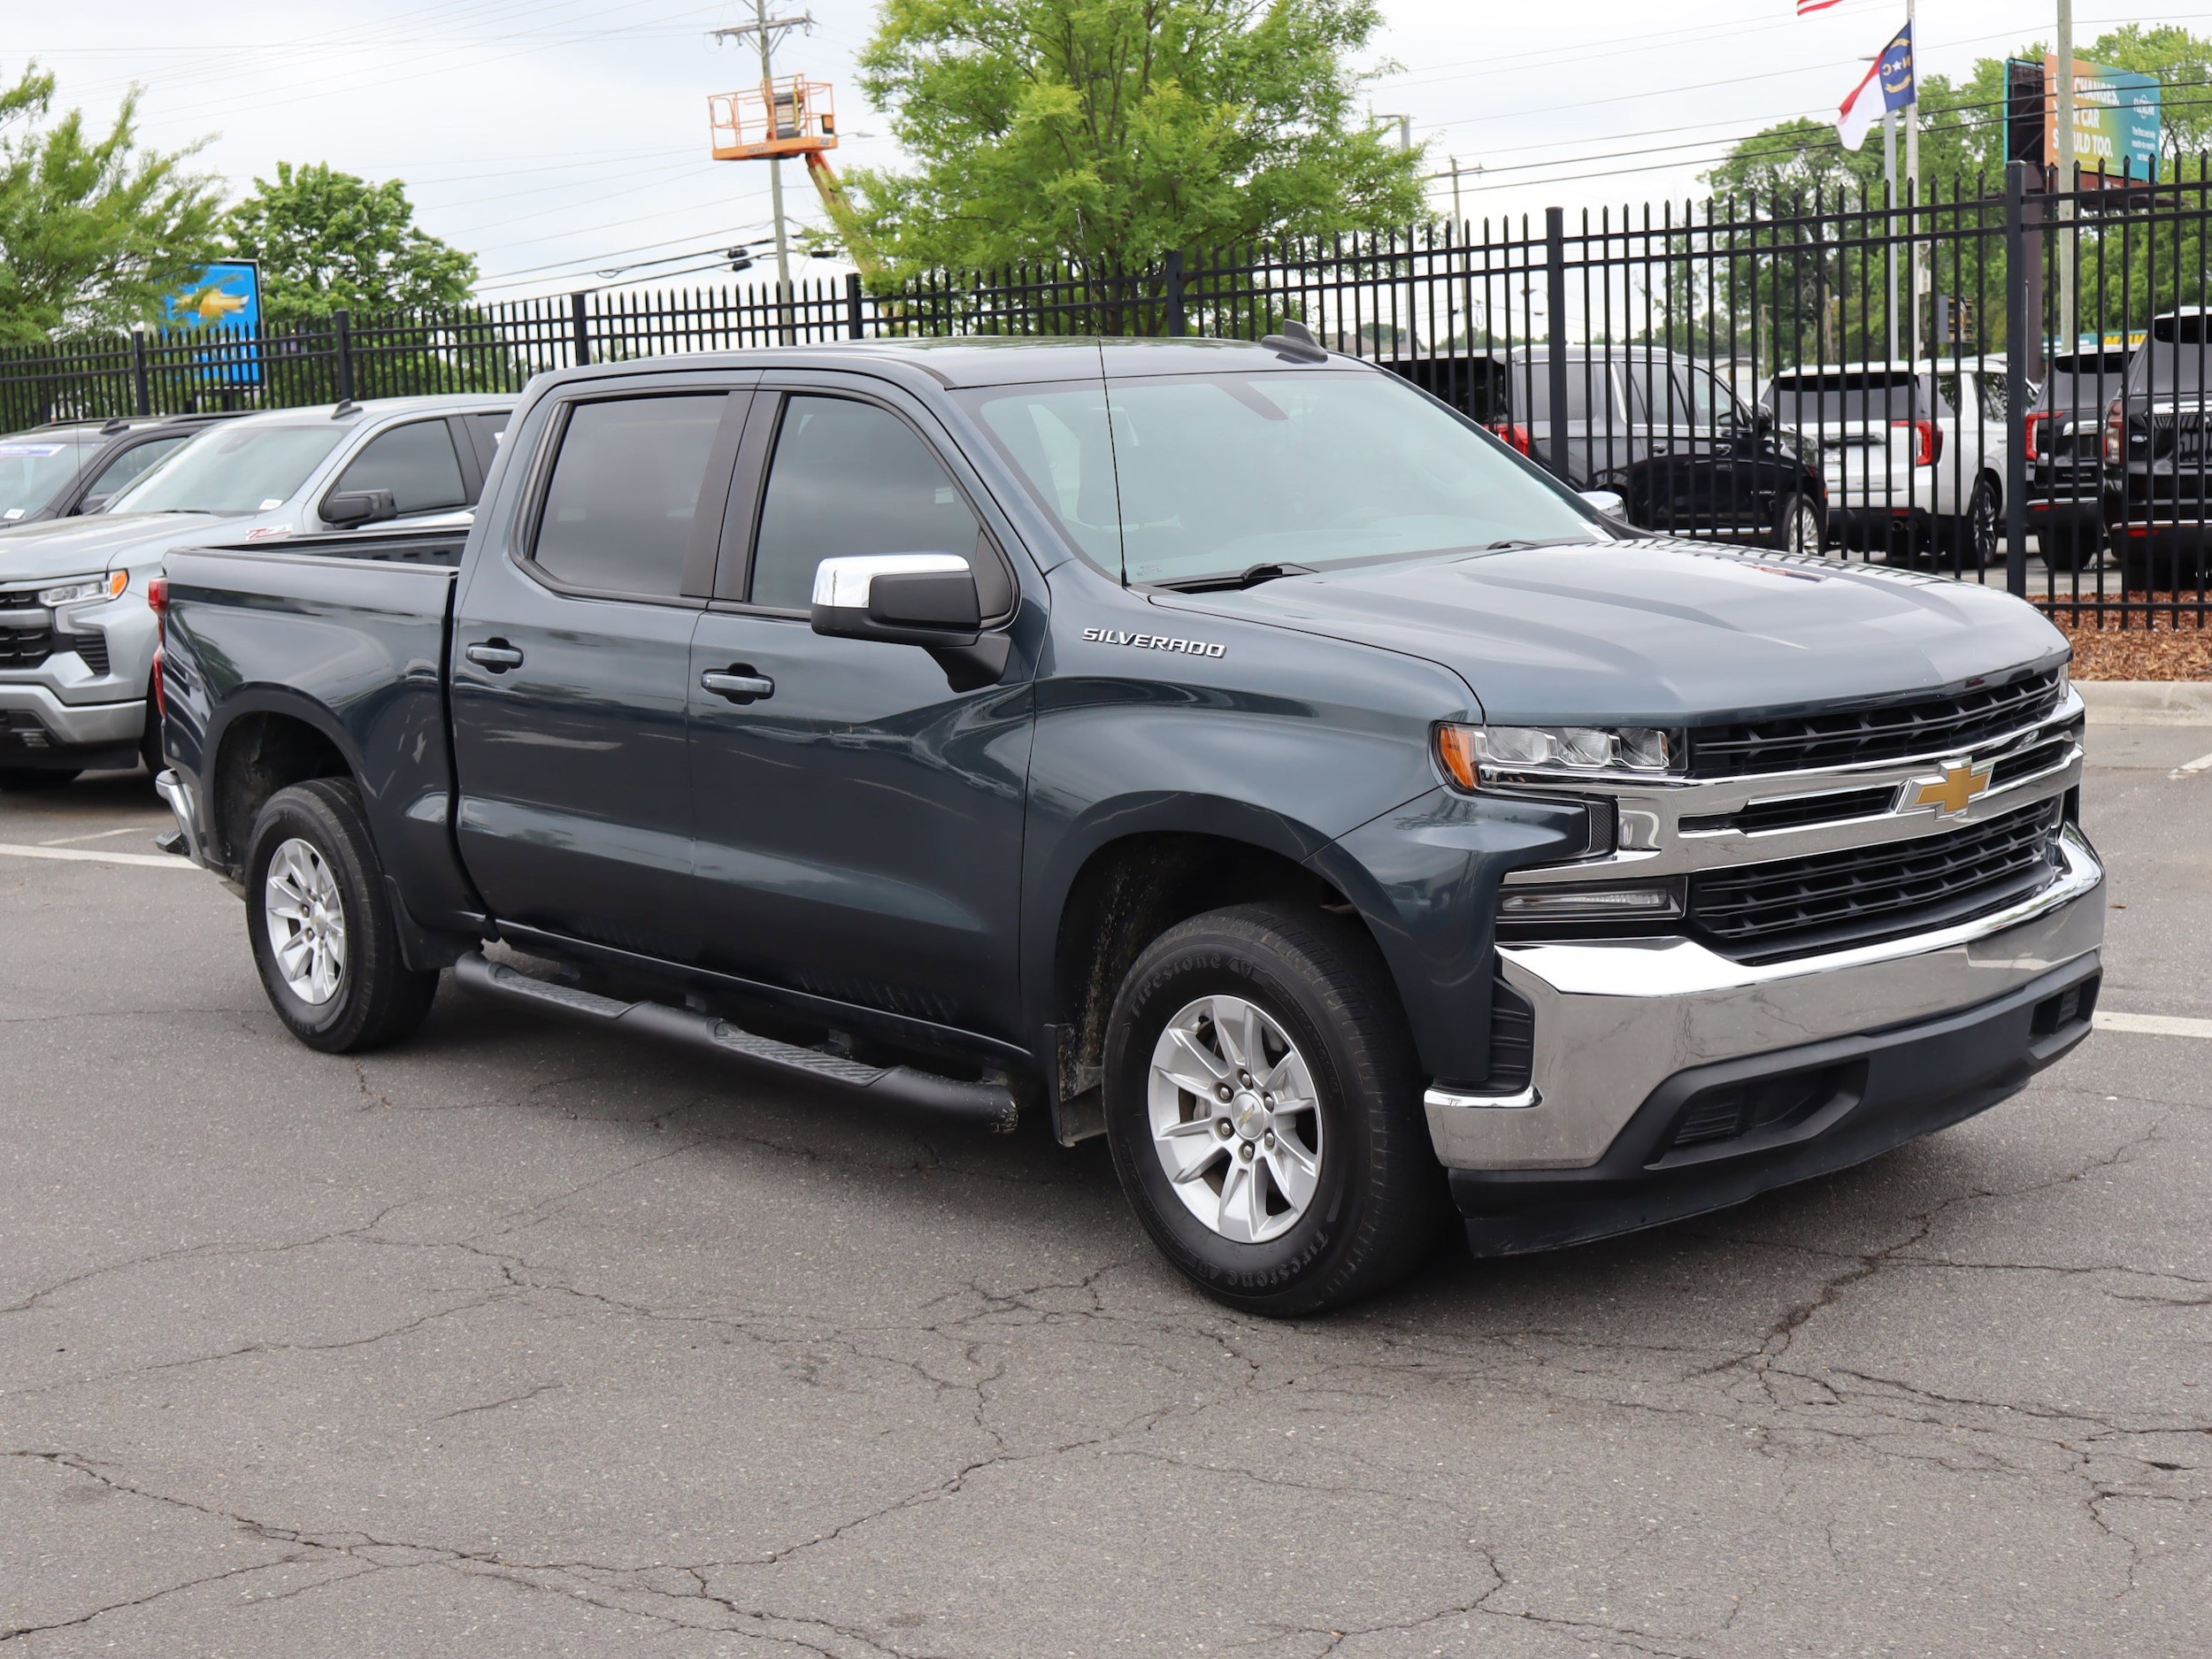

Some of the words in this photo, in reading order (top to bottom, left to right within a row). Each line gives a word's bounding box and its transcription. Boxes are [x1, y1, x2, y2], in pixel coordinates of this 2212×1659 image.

[2080, 107, 2101, 129] CAR
[2053, 127, 2091, 155] SULD
[1081, 626, 1227, 658] SILVERADO
[1130, 952, 1223, 1018] Firestone
[1225, 1228, 1330, 1288] Firestone
